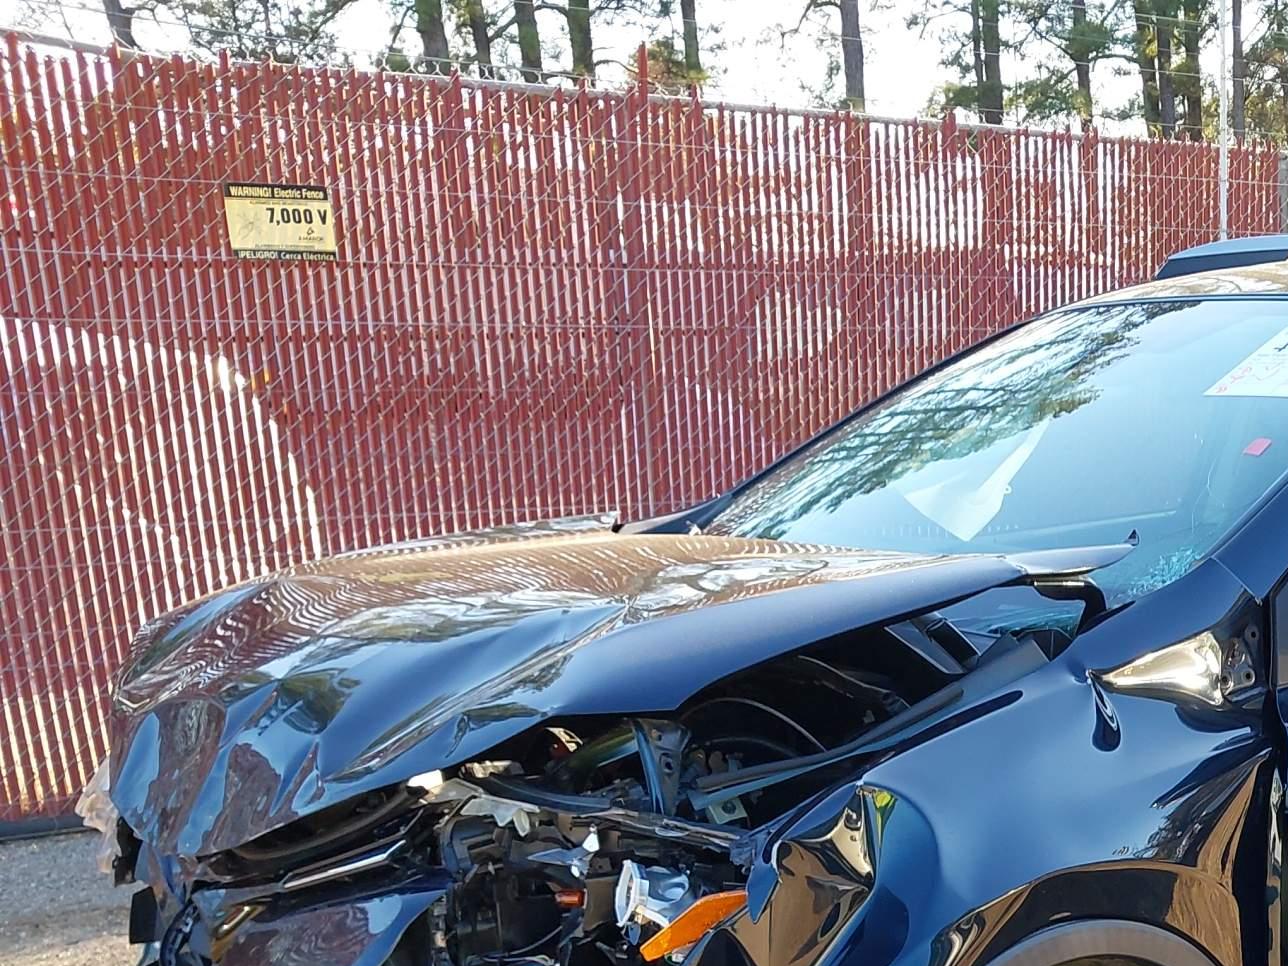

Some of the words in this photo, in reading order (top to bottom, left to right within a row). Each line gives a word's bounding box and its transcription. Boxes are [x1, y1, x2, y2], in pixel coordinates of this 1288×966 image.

[229, 186, 272, 198] WARNING!
[274, 188, 301, 198] Electric
[302, 189, 324, 199] Fence
[266, 207, 313, 226] 7,000
[317, 208, 327, 225] V
[280, 252, 302, 260] Cerca
